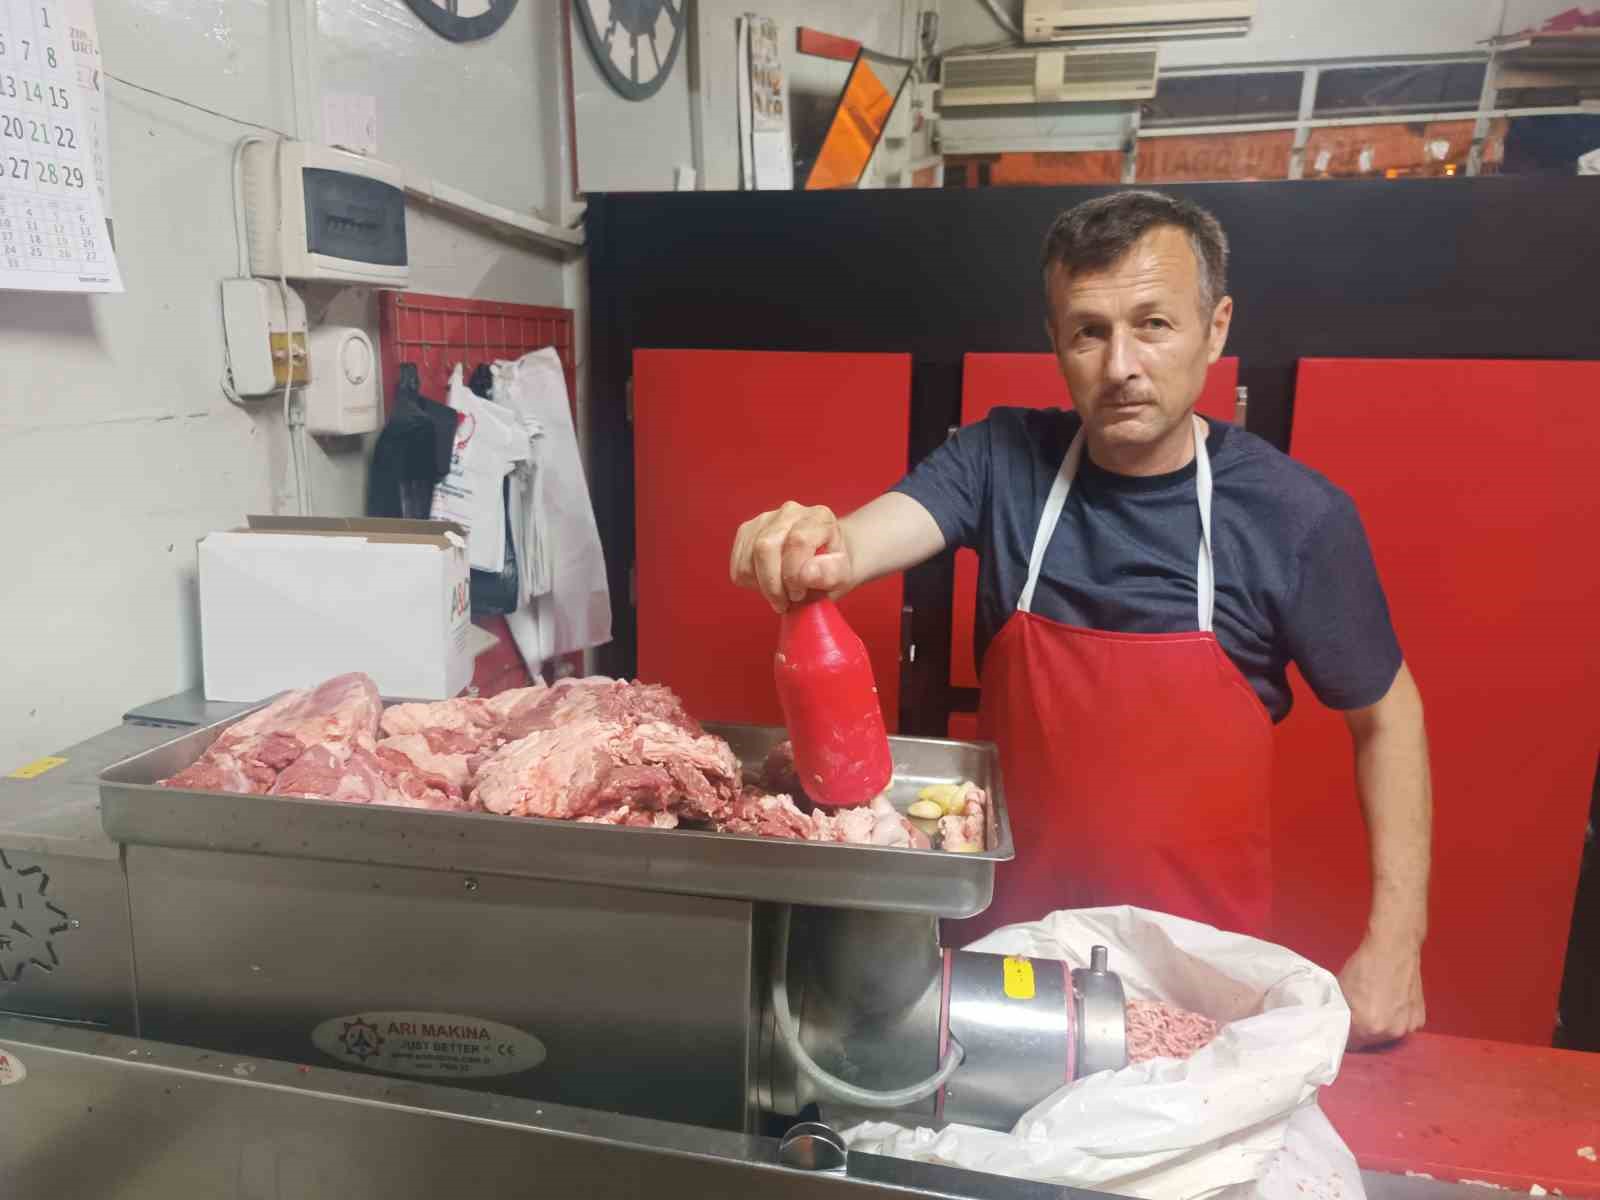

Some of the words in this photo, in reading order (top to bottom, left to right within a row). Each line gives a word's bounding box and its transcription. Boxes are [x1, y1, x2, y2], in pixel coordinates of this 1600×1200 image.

[42, 7, 51, 28] 1
[21, 40, 30, 60] 7
[47, 46, 57, 68] 8
[0, 73, 17, 98] 13
[23, 80, 43, 103] 14
[49, 86, 69, 109] 15
[1, 115, 24, 139] 20
[29, 120, 50, 144] 21
[55, 125, 77, 149] 22
[9, 156, 30, 180] 27
[36, 161, 59, 185] 28
[62, 165, 84, 188] 29
[387, 1022, 416, 1037] ARI
[421, 1023, 491, 1041] MAKINA
[433, 1042, 480, 1055] BETTER
